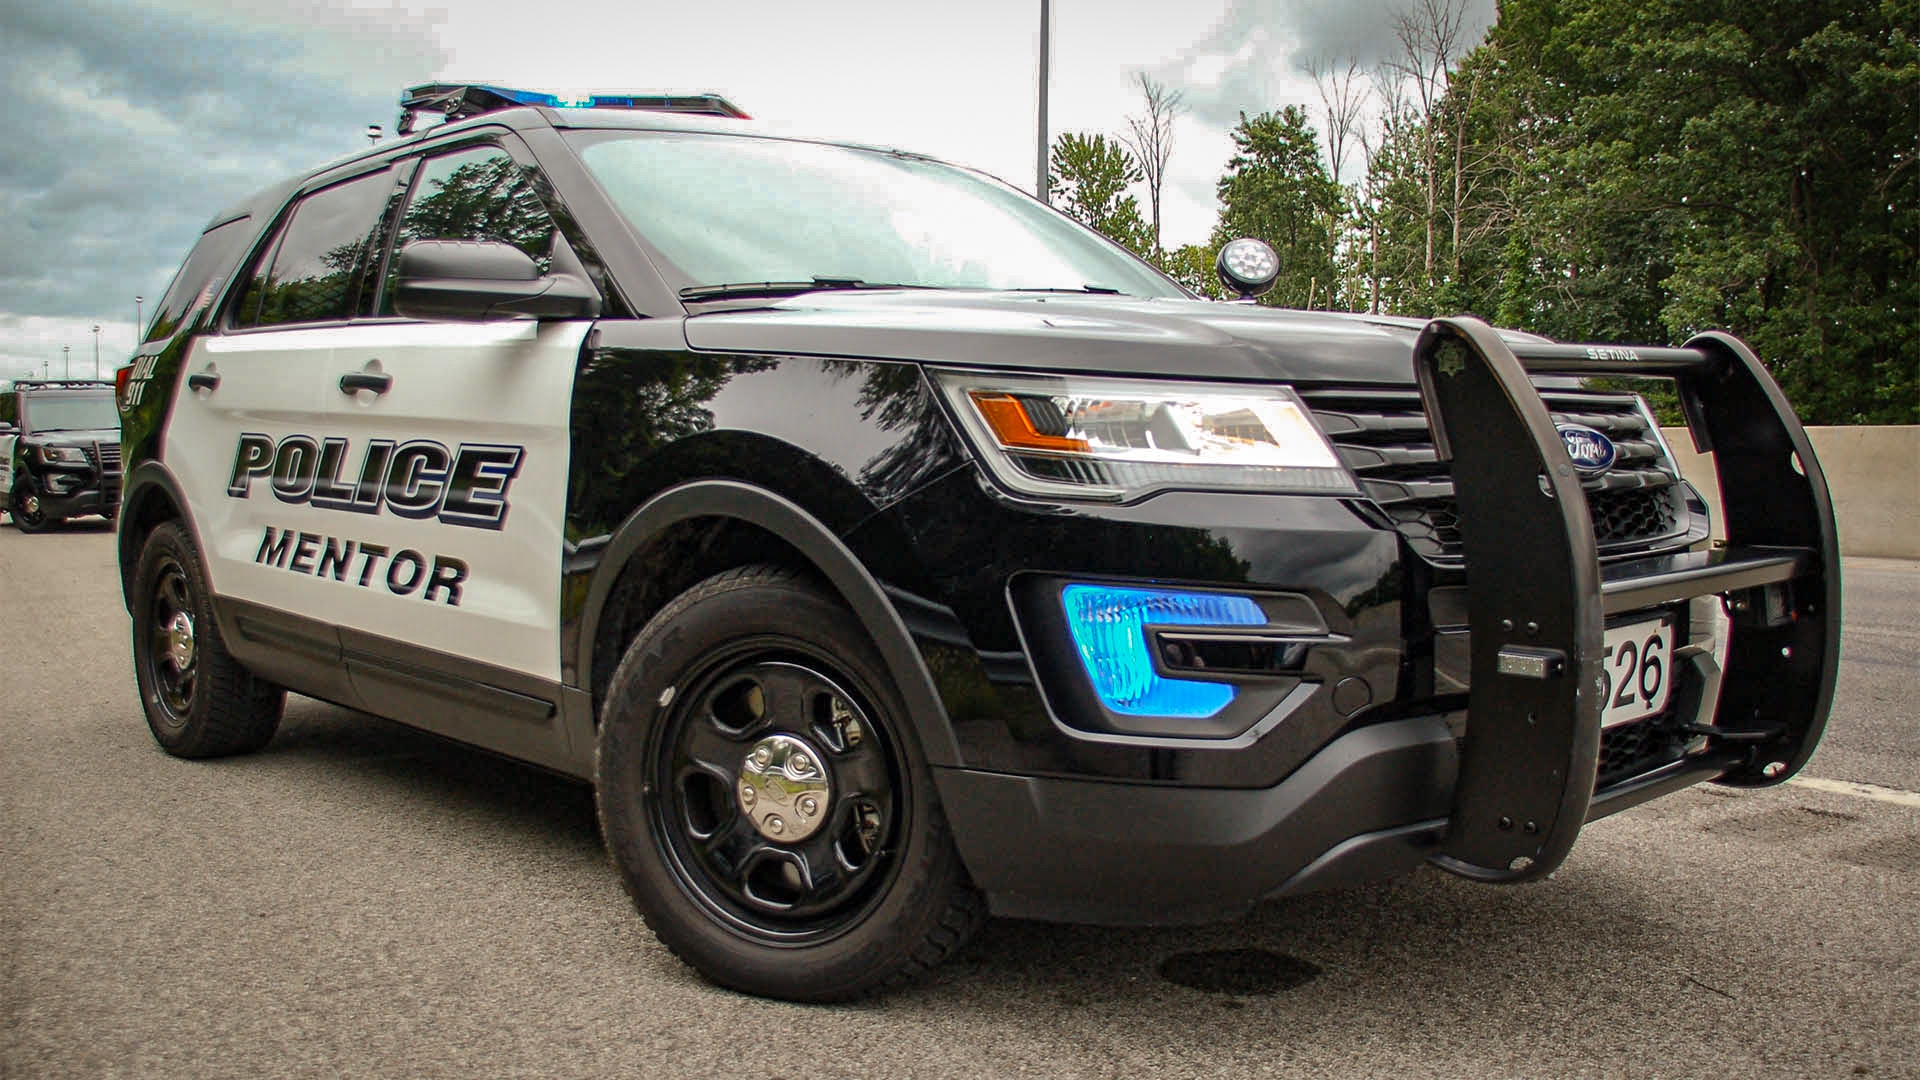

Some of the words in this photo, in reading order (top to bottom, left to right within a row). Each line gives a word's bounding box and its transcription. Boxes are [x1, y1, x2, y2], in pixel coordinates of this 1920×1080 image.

[131, 355, 159, 379] DIAL
[1586, 348, 1639, 361] SETINA
[125, 382, 146, 405] 911
[1565, 430, 1606, 460] Ford
[227, 432, 527, 531] POLICE
[255, 525, 470, 606] MENTOR
